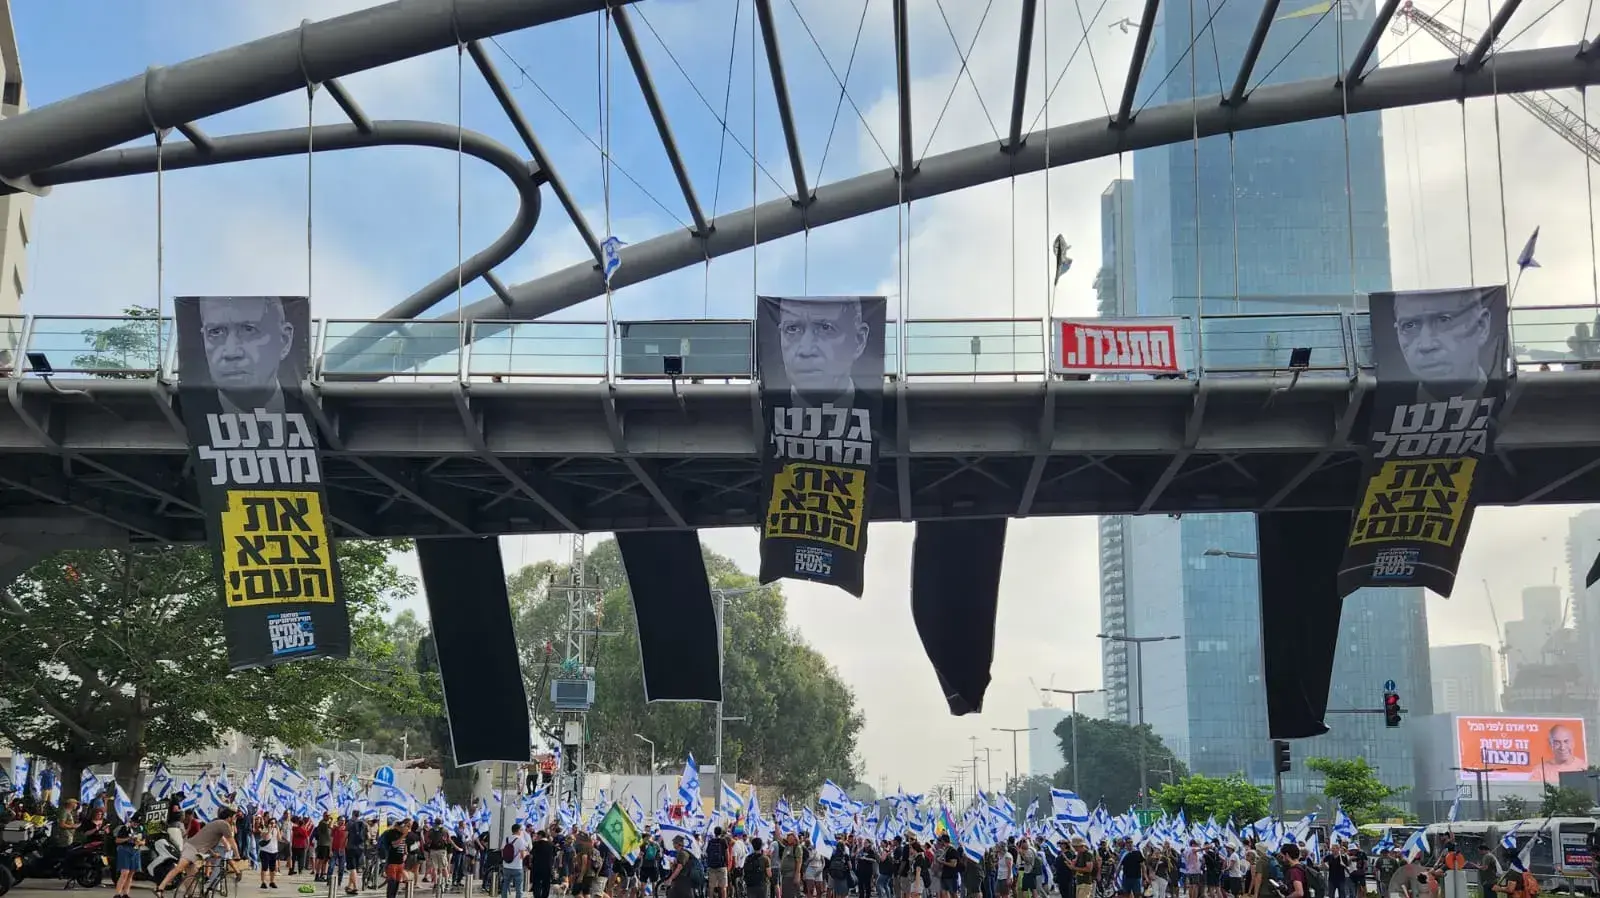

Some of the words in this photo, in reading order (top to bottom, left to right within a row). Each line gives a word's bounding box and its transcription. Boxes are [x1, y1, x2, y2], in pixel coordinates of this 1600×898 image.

[1335, 0, 1371, 19] EY
[206, 407, 314, 448] גלנט
[774, 403, 872, 442] גלנט
[1391, 396, 1496, 434] גלנט
[1372, 429, 1487, 459] מחסל
[198, 445, 320, 485] מחסל
[1386, 461, 1463, 490] את
[793, 467, 854, 496] את
[242, 497, 312, 531] את
[780, 489, 856, 521] צבא
[1369, 489, 1459, 516] צבא
[769, 512, 856, 546] העם!
[1354, 515, 1454, 541] העם!
[234, 534, 321, 566] צבא
[229, 568, 329, 601] העם!
[268, 622, 303, 639] אחים
[271, 631, 314, 652] לנשק
[1506, 723, 1525, 732] אדם
[1526, 723, 1539, 732] בני
[1480, 738, 1513, 749] שירות
[1515, 739, 1529, 749] זה
